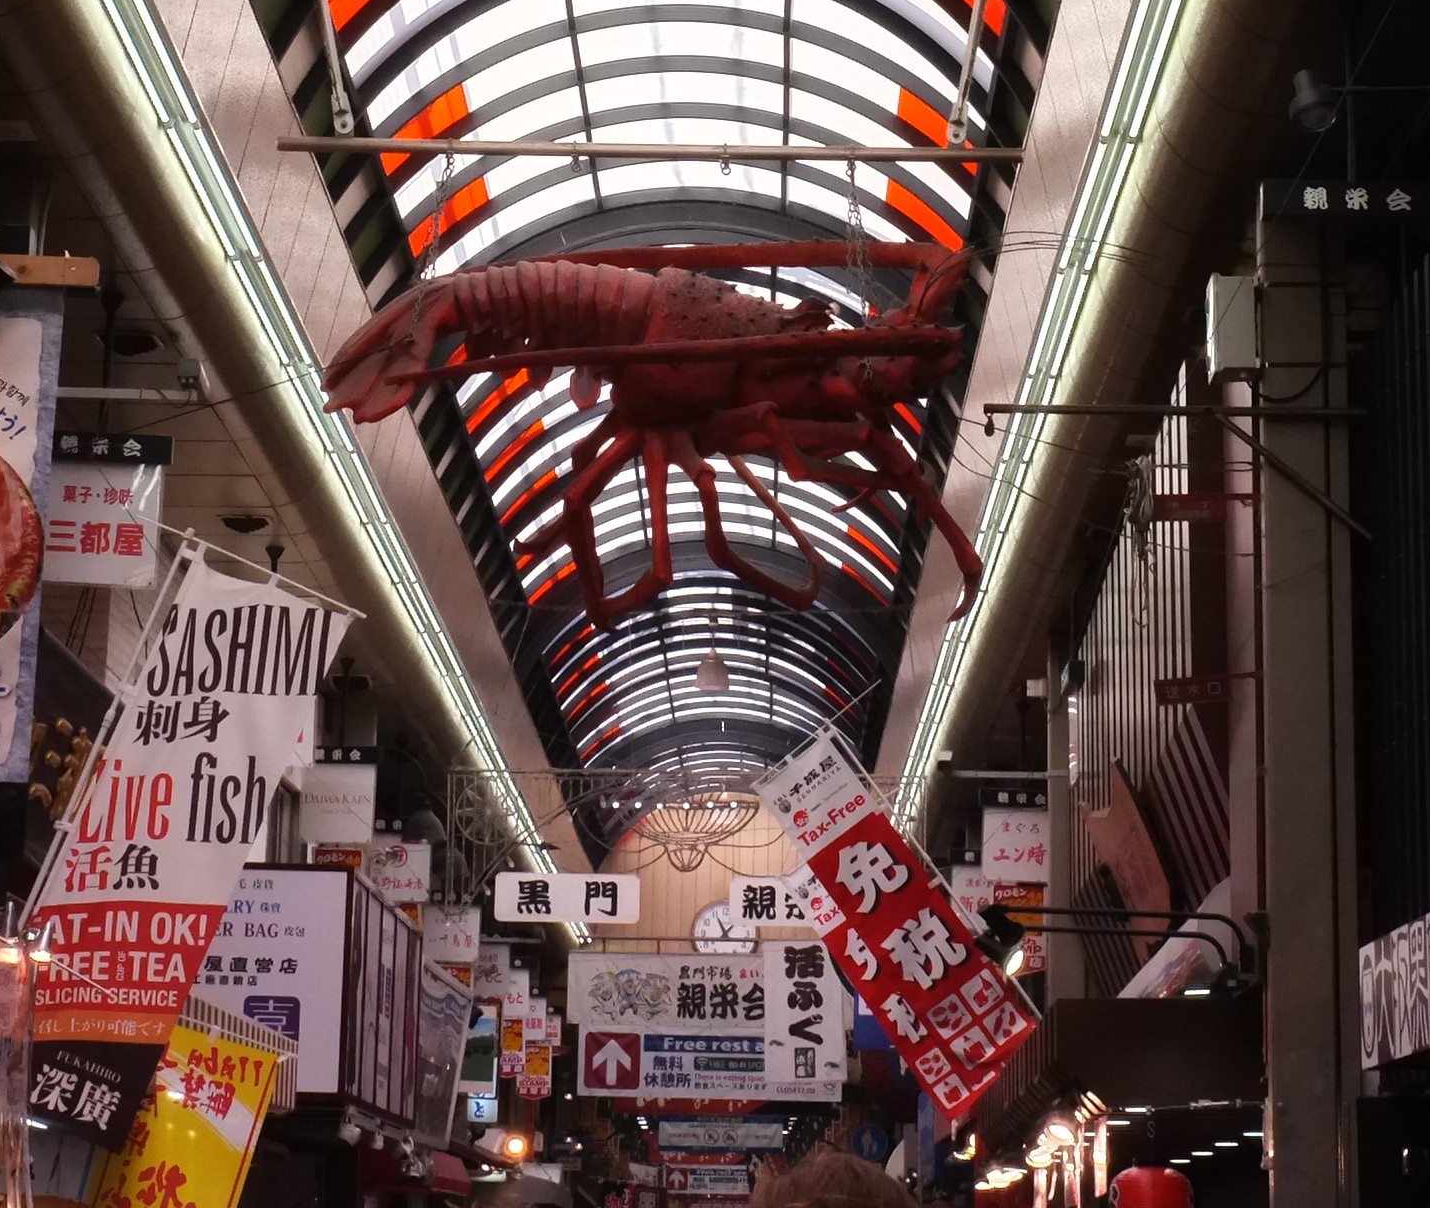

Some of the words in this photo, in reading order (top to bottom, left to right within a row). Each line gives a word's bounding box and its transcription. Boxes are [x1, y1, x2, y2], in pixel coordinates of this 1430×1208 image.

[1303, 186, 1412, 211] 親栄会
[46, 520, 144, 556] 三都屋
[147, 604, 332, 696] SASHIMI
[133, 697, 230, 745] 刺身
[77, 759, 174, 843] Live
[185, 752, 267, 844] fish
[797, 794, 866, 846] Tax-Free
[64, 844, 159, 893] 活魚
[517, 880, 618, 916] 黒門
[835, 841, 967, 990] 免税
[33, 911, 138, 946] AT-IN
[151, 911, 208, 947] OK!
[245, 923, 278, 938] BAG
[128, 950, 186, 983] TEA
[678, 965, 732, 982] 黒門市場
[35, 987, 102, 1006] SLICING
[108, 988, 178, 1008] SERVICE
[784, 944, 825, 1045] 活ふぐ
[33, 1018, 166, 1037] 召し上がり可能です
[663, 1037, 706, 1051] Free
[712, 1039, 750, 1052] rest
[56, 1050, 121, 1084] FUKAHIRO
[644, 1072, 691, 1089] 休憩所
[653, 1055, 683, 1072] 無料
[723, 1074, 746, 1083] eating
[29, 1064, 121, 1131] 深廣
